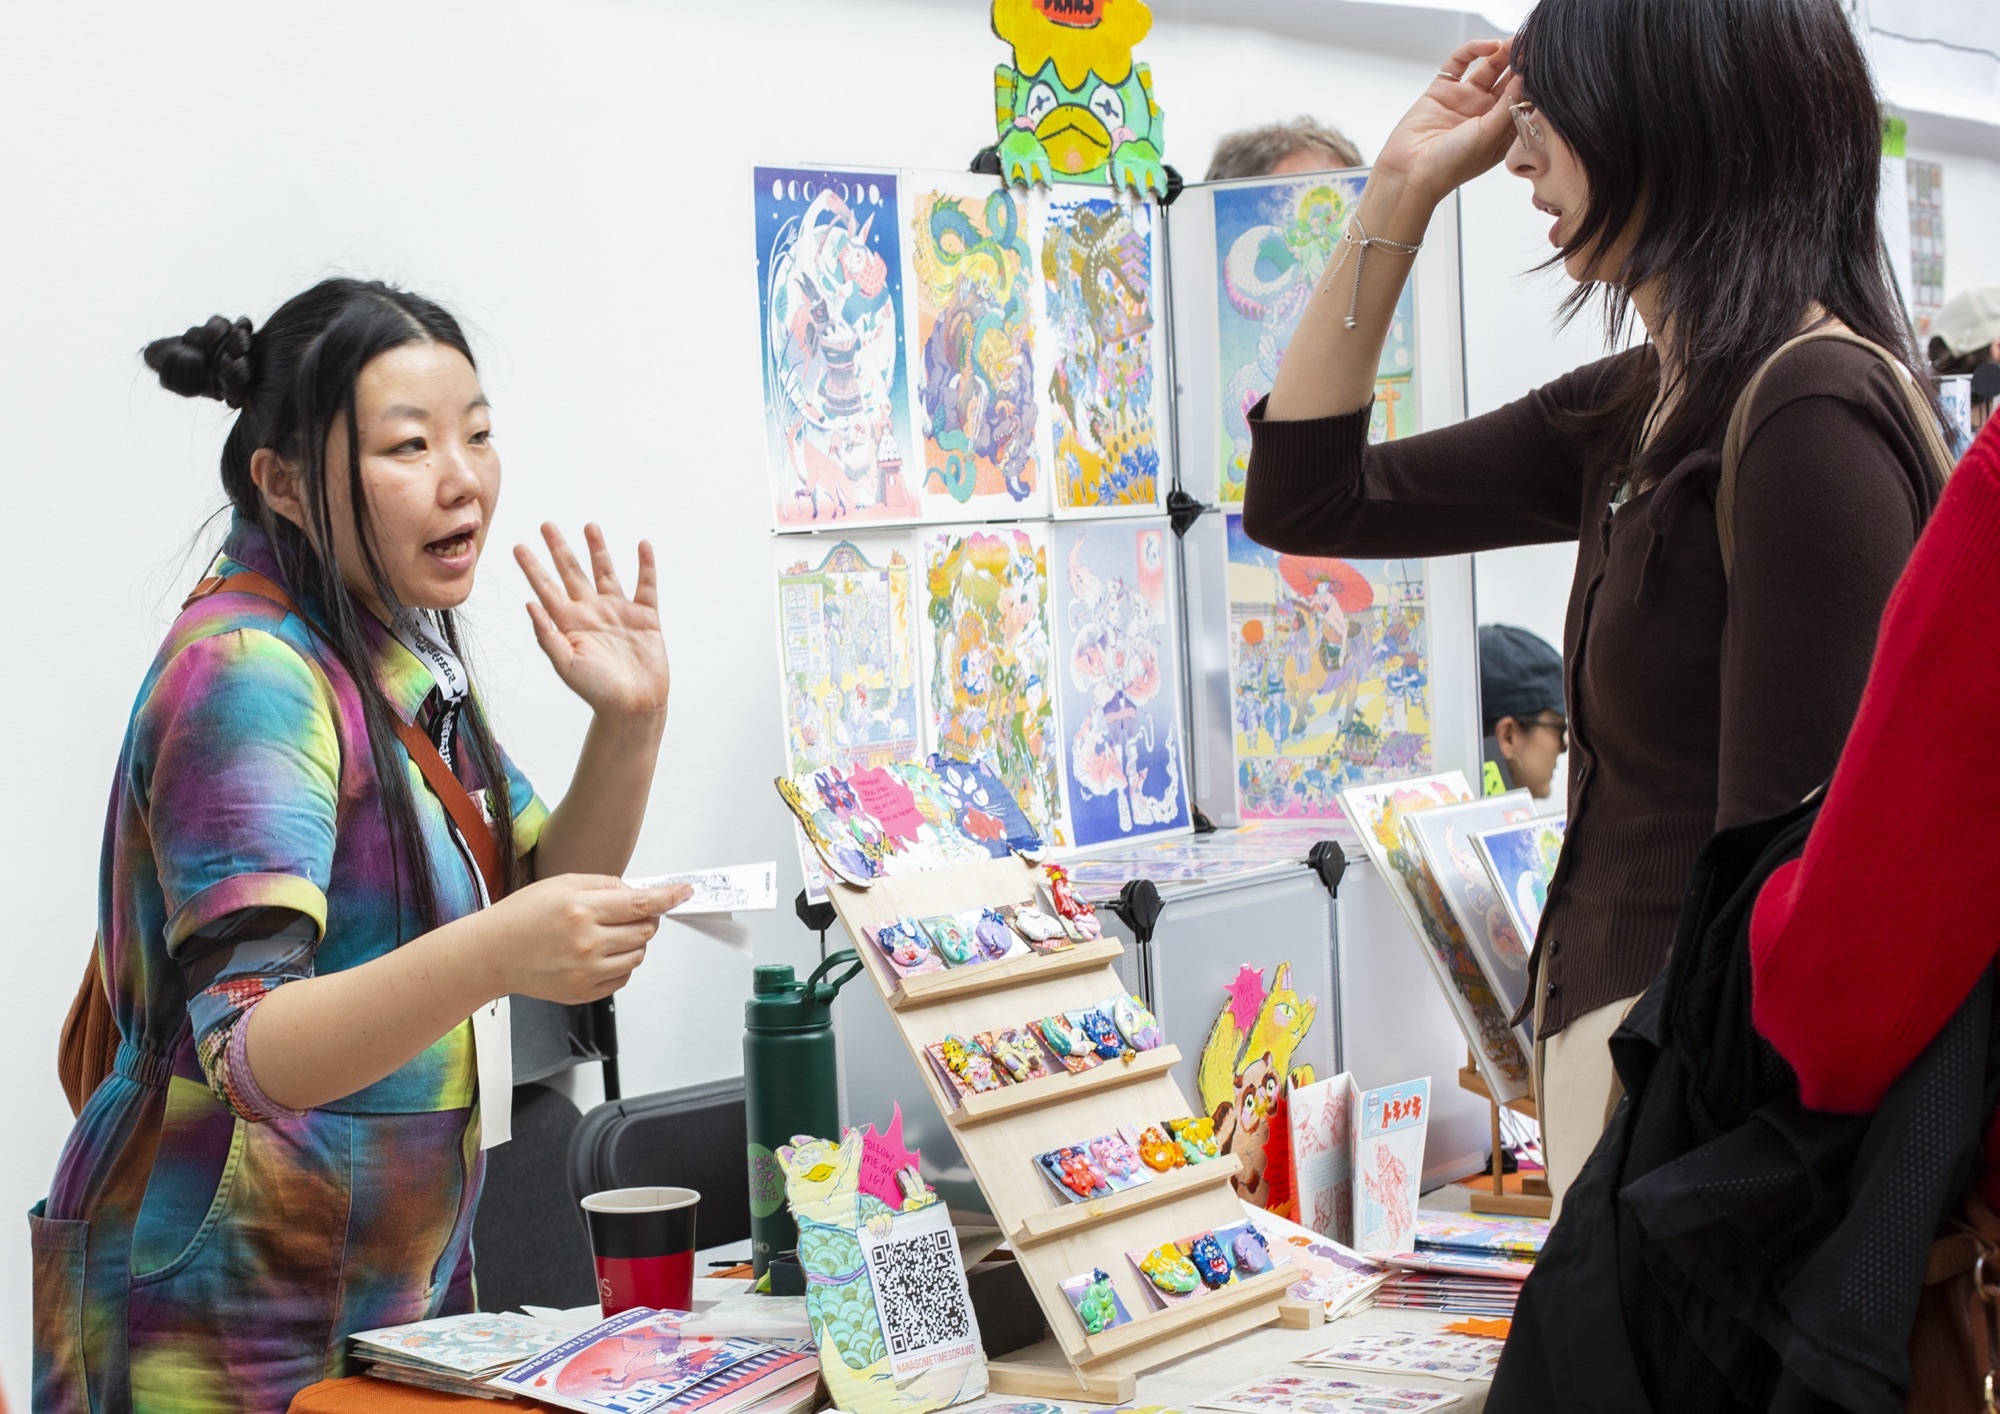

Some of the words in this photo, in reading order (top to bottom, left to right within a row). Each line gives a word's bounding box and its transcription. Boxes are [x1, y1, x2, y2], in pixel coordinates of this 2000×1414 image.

[863, 1139, 895, 1162] FOLLOW
[863, 1154, 879, 1169] ME
[880, 1164, 894, 1176] ON
[896, 1344, 976, 1374] NANASOMETIMESDRAWS
